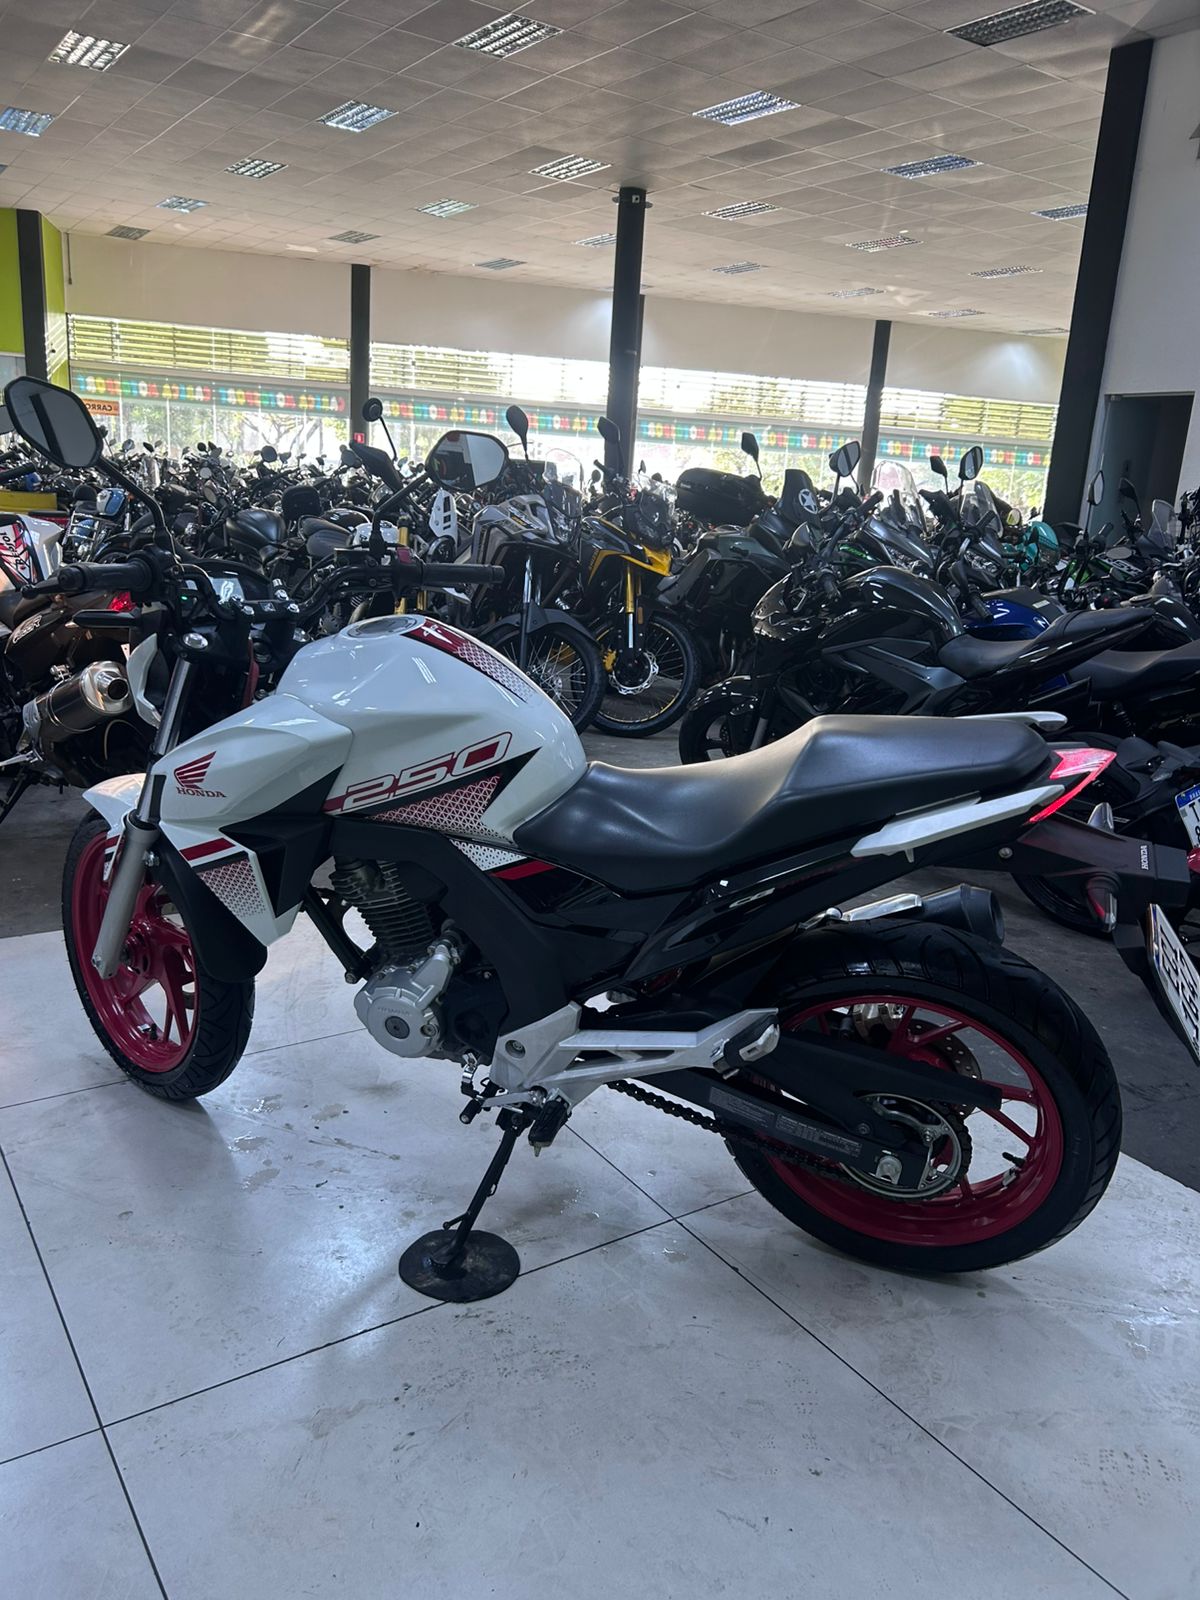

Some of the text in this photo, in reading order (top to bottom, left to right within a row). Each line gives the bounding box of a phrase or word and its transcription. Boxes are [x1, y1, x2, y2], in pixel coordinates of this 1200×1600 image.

[340, 731, 512, 811] 250
[176, 786, 227, 798] HONDA
[1140, 845, 1149, 870] HONDA
